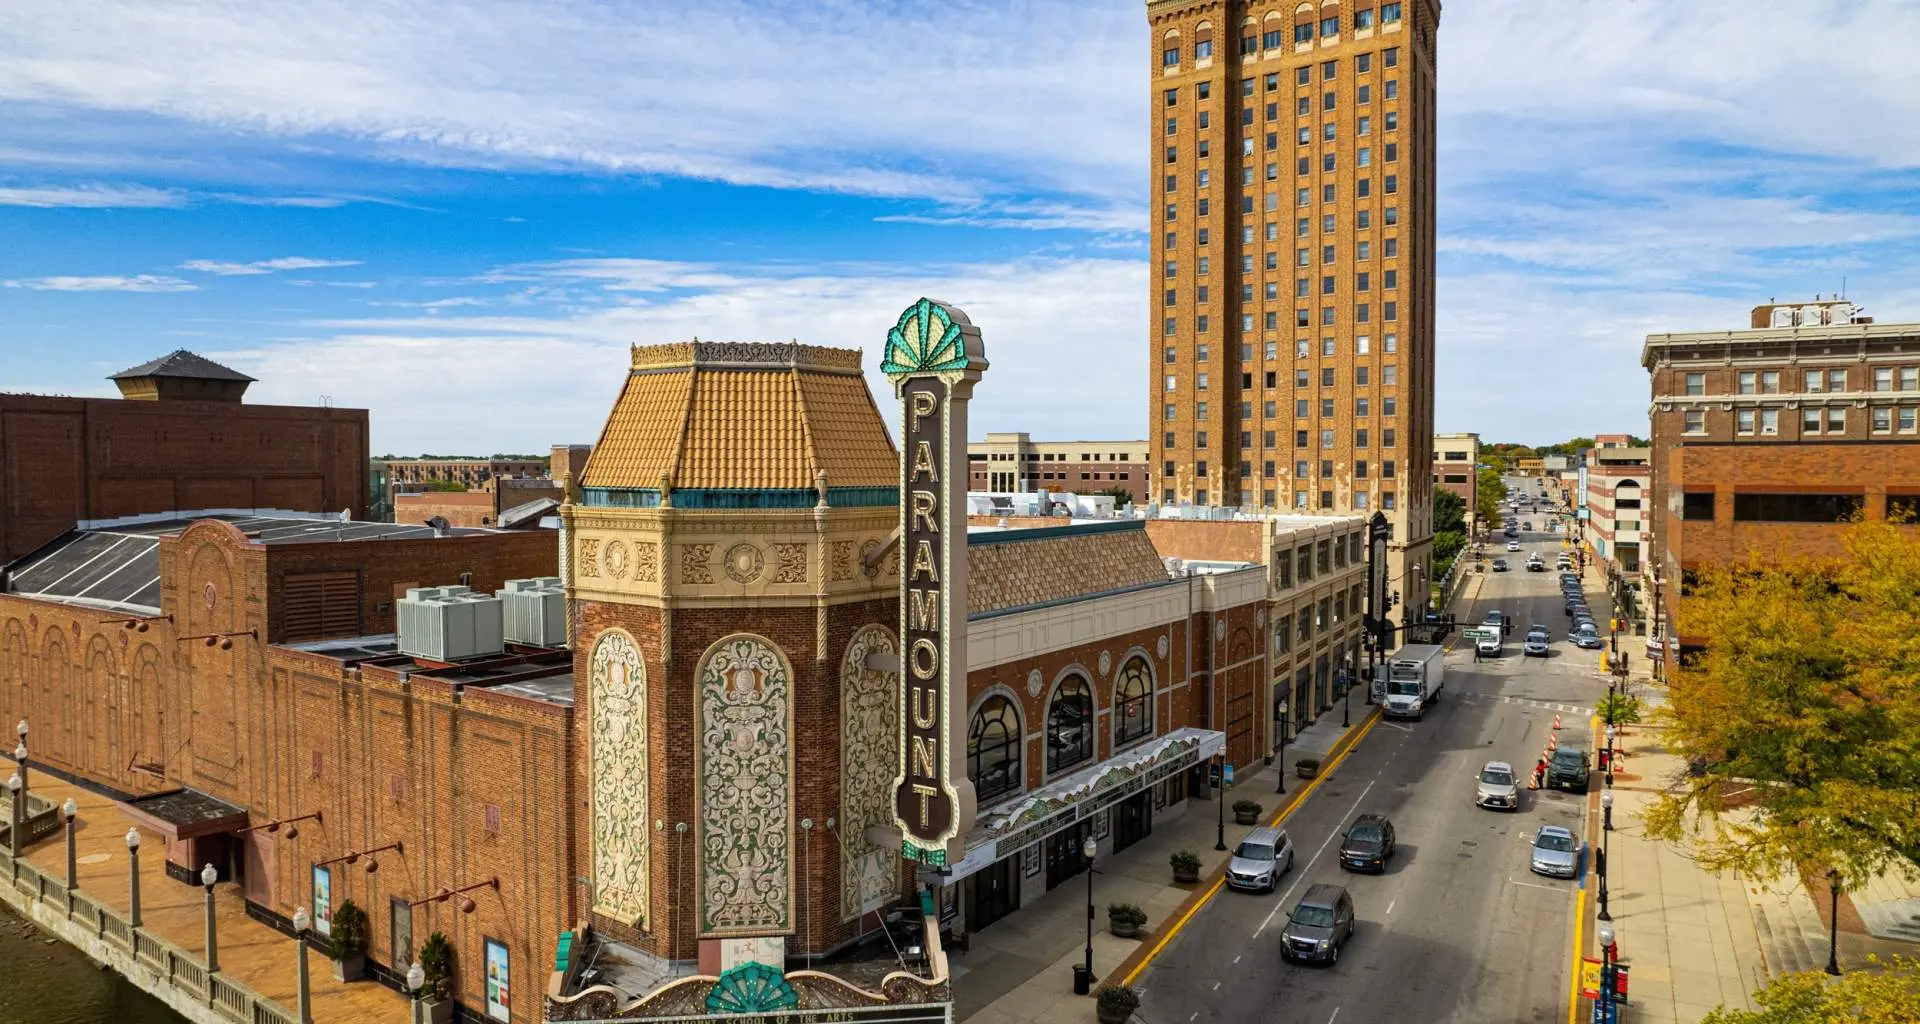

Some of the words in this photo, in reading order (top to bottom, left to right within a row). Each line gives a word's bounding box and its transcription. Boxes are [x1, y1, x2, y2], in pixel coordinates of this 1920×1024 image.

[910, 391, 938, 829] PARAMOUNT
[726, 1016, 766, 1024] SCHOOL
[776, 1015, 790, 1024] OF
[799, 1014, 817, 1023] THE
[826, 1012, 854, 1022] ARTS
